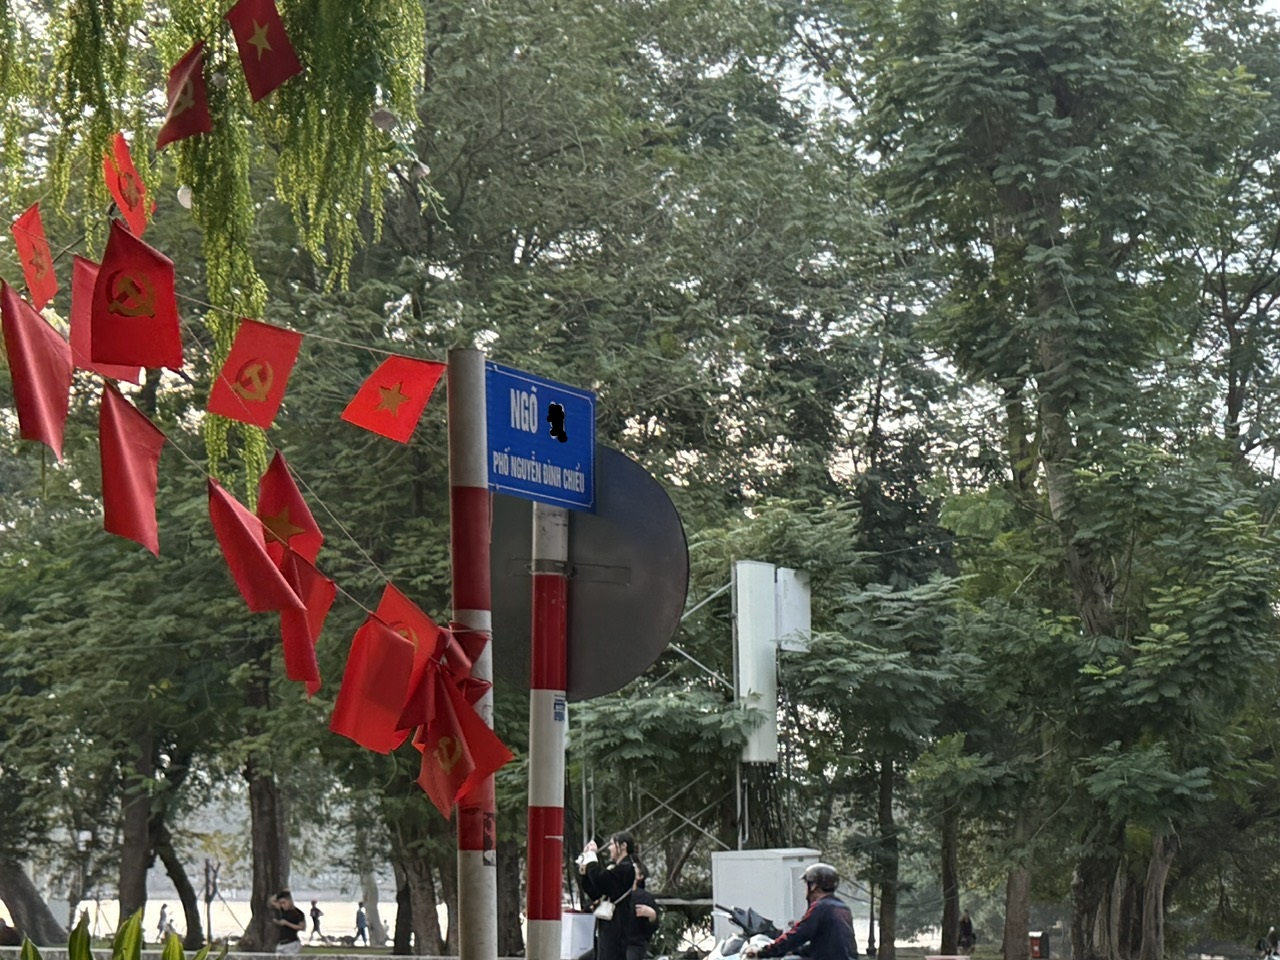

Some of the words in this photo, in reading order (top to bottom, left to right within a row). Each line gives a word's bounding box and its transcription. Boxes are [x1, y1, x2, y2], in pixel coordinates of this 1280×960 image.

[510, 386, 538, 433] NGÕ
[492, 447, 510, 476] PHỐ
[511, 451, 541, 484] NGUYỄN
[543, 459, 561, 487] ĐÌNH
[562, 462, 585, 494] CHIỂU
